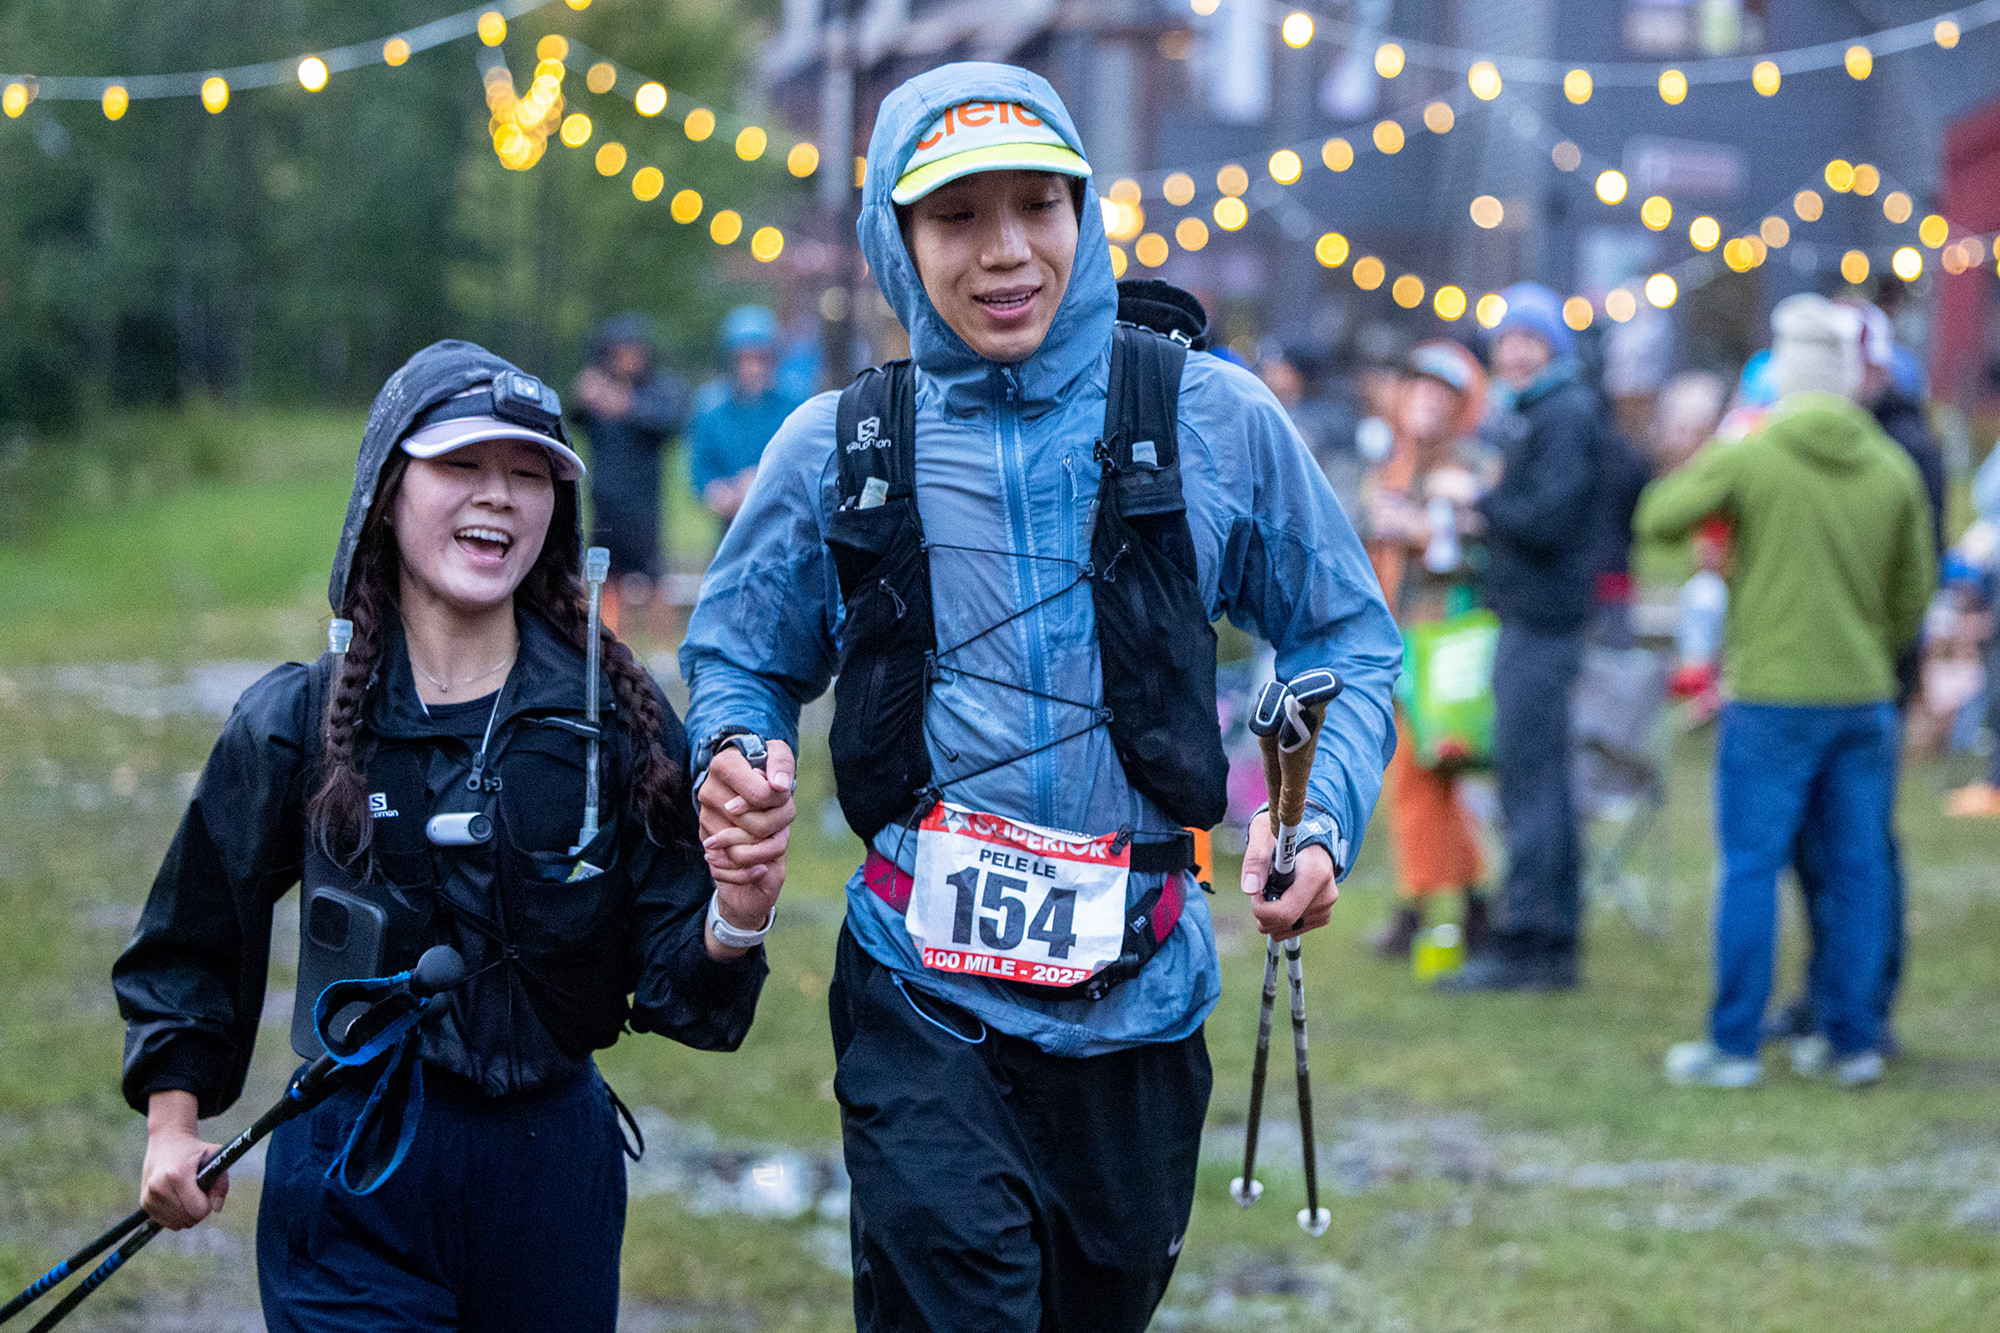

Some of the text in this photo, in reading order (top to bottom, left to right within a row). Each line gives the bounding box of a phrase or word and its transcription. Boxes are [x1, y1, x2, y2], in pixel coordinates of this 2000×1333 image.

[973, 815, 1107, 859] SUPERIOR
[979, 848, 1056, 879] PELE LE
[946, 866, 1077, 960] 154
[925, 950, 960, 969] 100
[964, 955, 1016, 976] MILE
[1031, 965, 1086, 984] 2025
